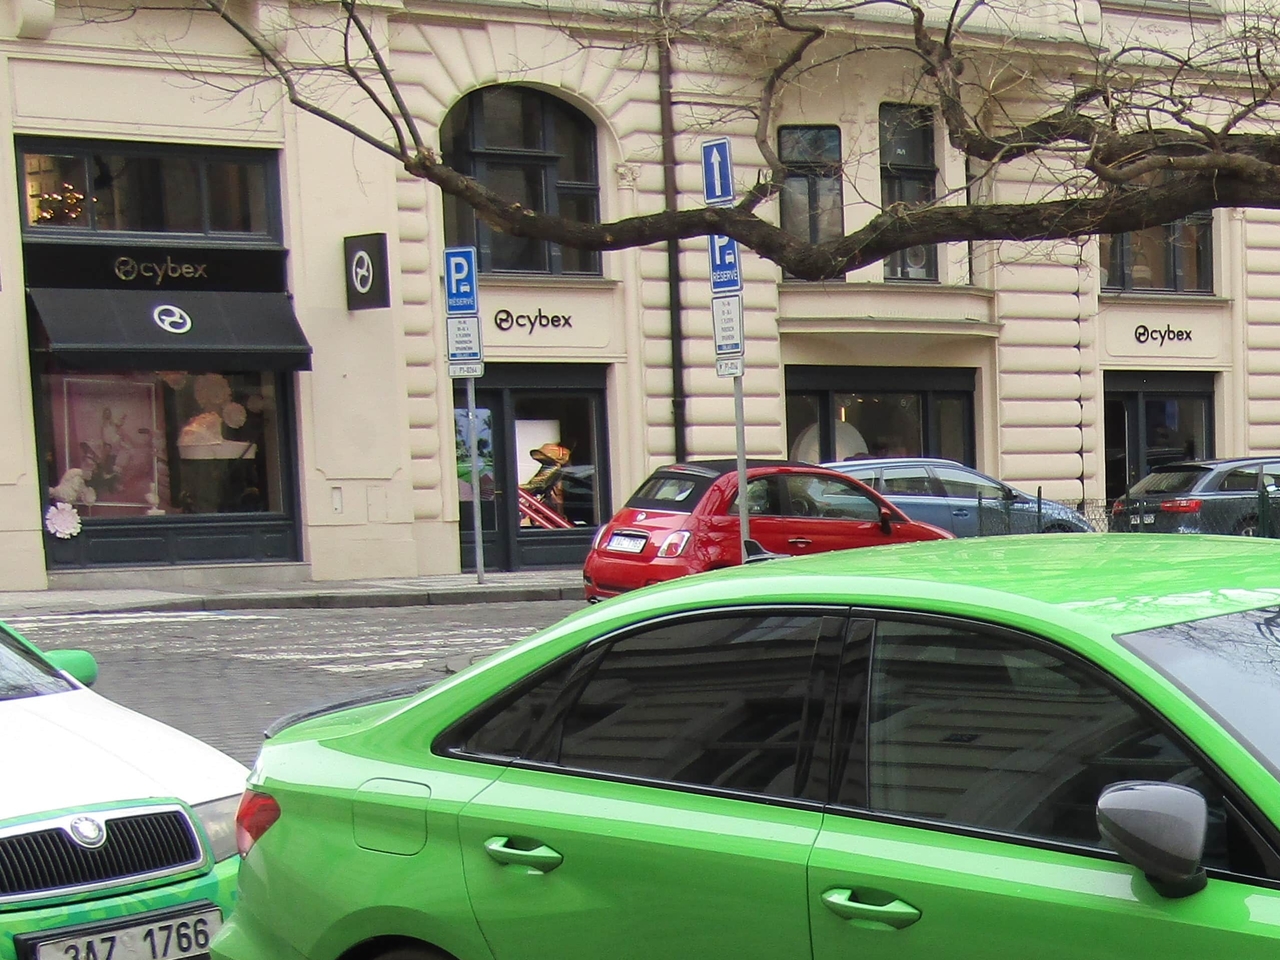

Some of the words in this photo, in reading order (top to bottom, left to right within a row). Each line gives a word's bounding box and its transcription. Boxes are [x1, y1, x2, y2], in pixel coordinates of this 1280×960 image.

[140, 256, 207, 286] cybex
[450, 257, 468, 294] P
[515, 308, 573, 335] cybex
[1150, 324, 1193, 347] cybex
[143, 918, 210, 960] 1766
